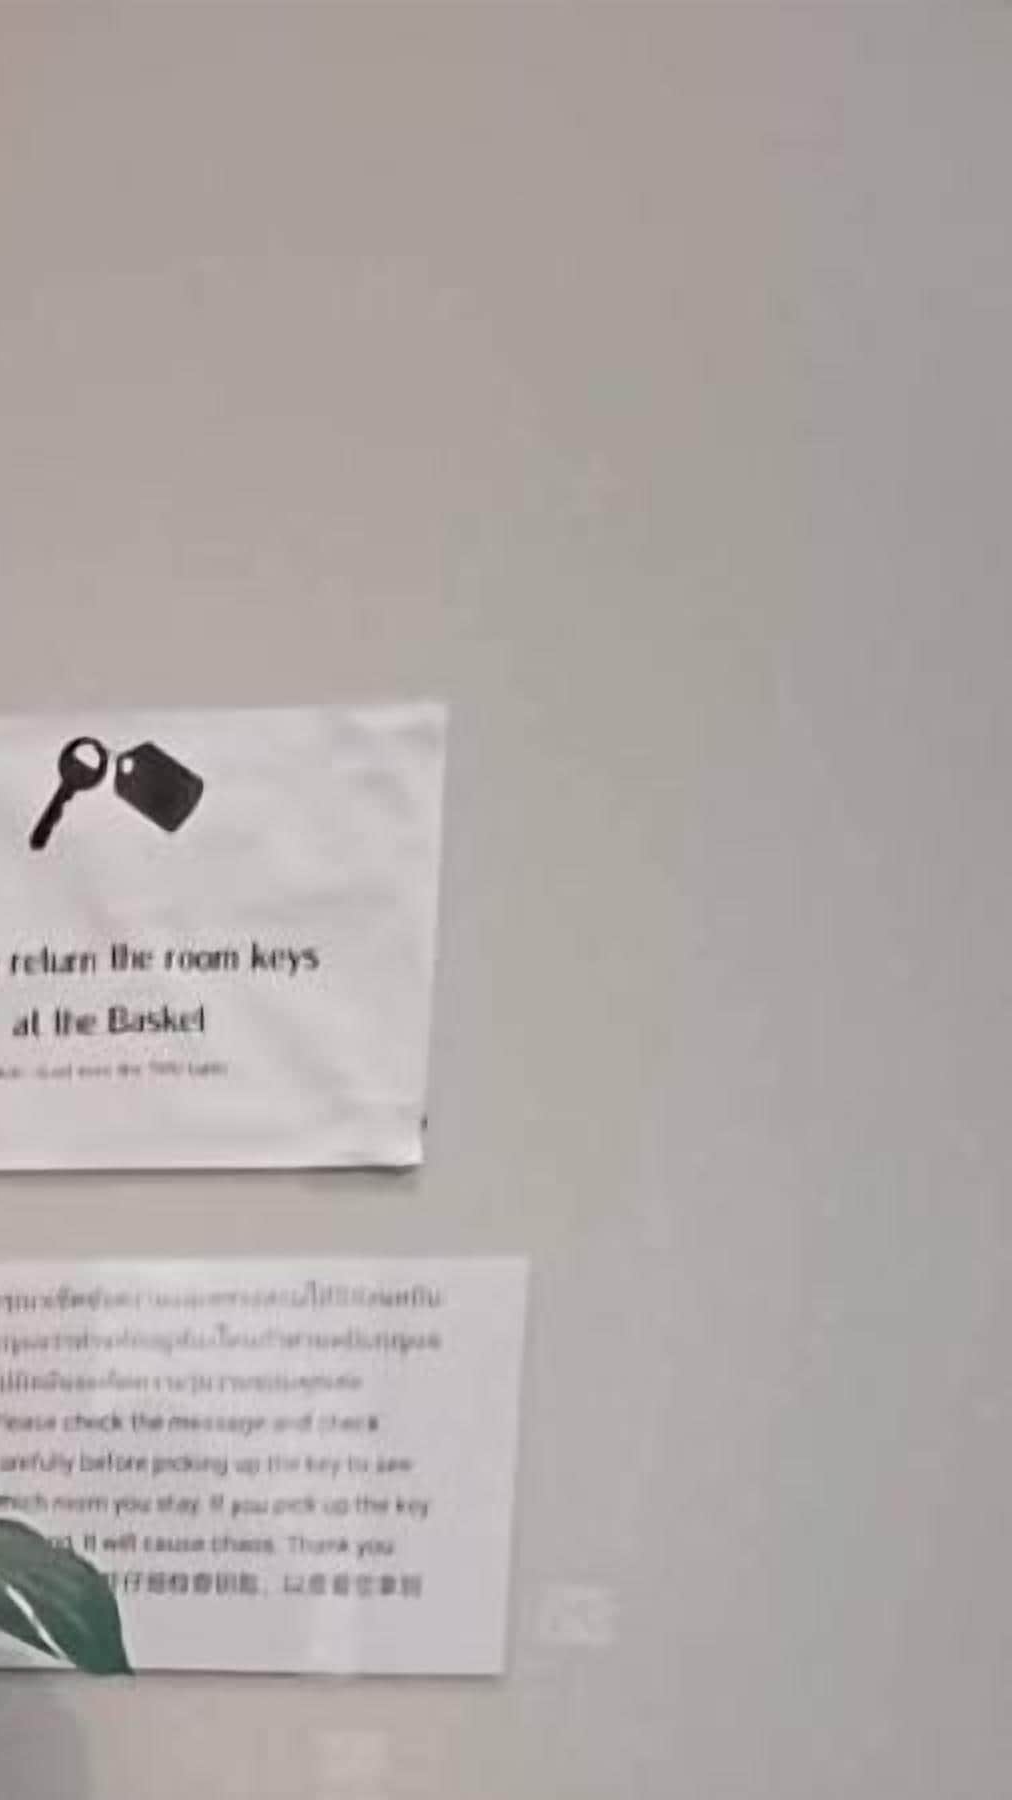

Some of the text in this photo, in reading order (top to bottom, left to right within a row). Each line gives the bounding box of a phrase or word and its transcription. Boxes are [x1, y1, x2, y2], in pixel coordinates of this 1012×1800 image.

[110, 942, 153, 973] the
[164, 943, 239, 971] room
[250, 940, 320, 977] keys
[55, 1008, 97, 1037] the
[63, 1414, 122, 1431] check
[131, 1414, 163, 1431] the
[80, 1453, 146, 1471] before
